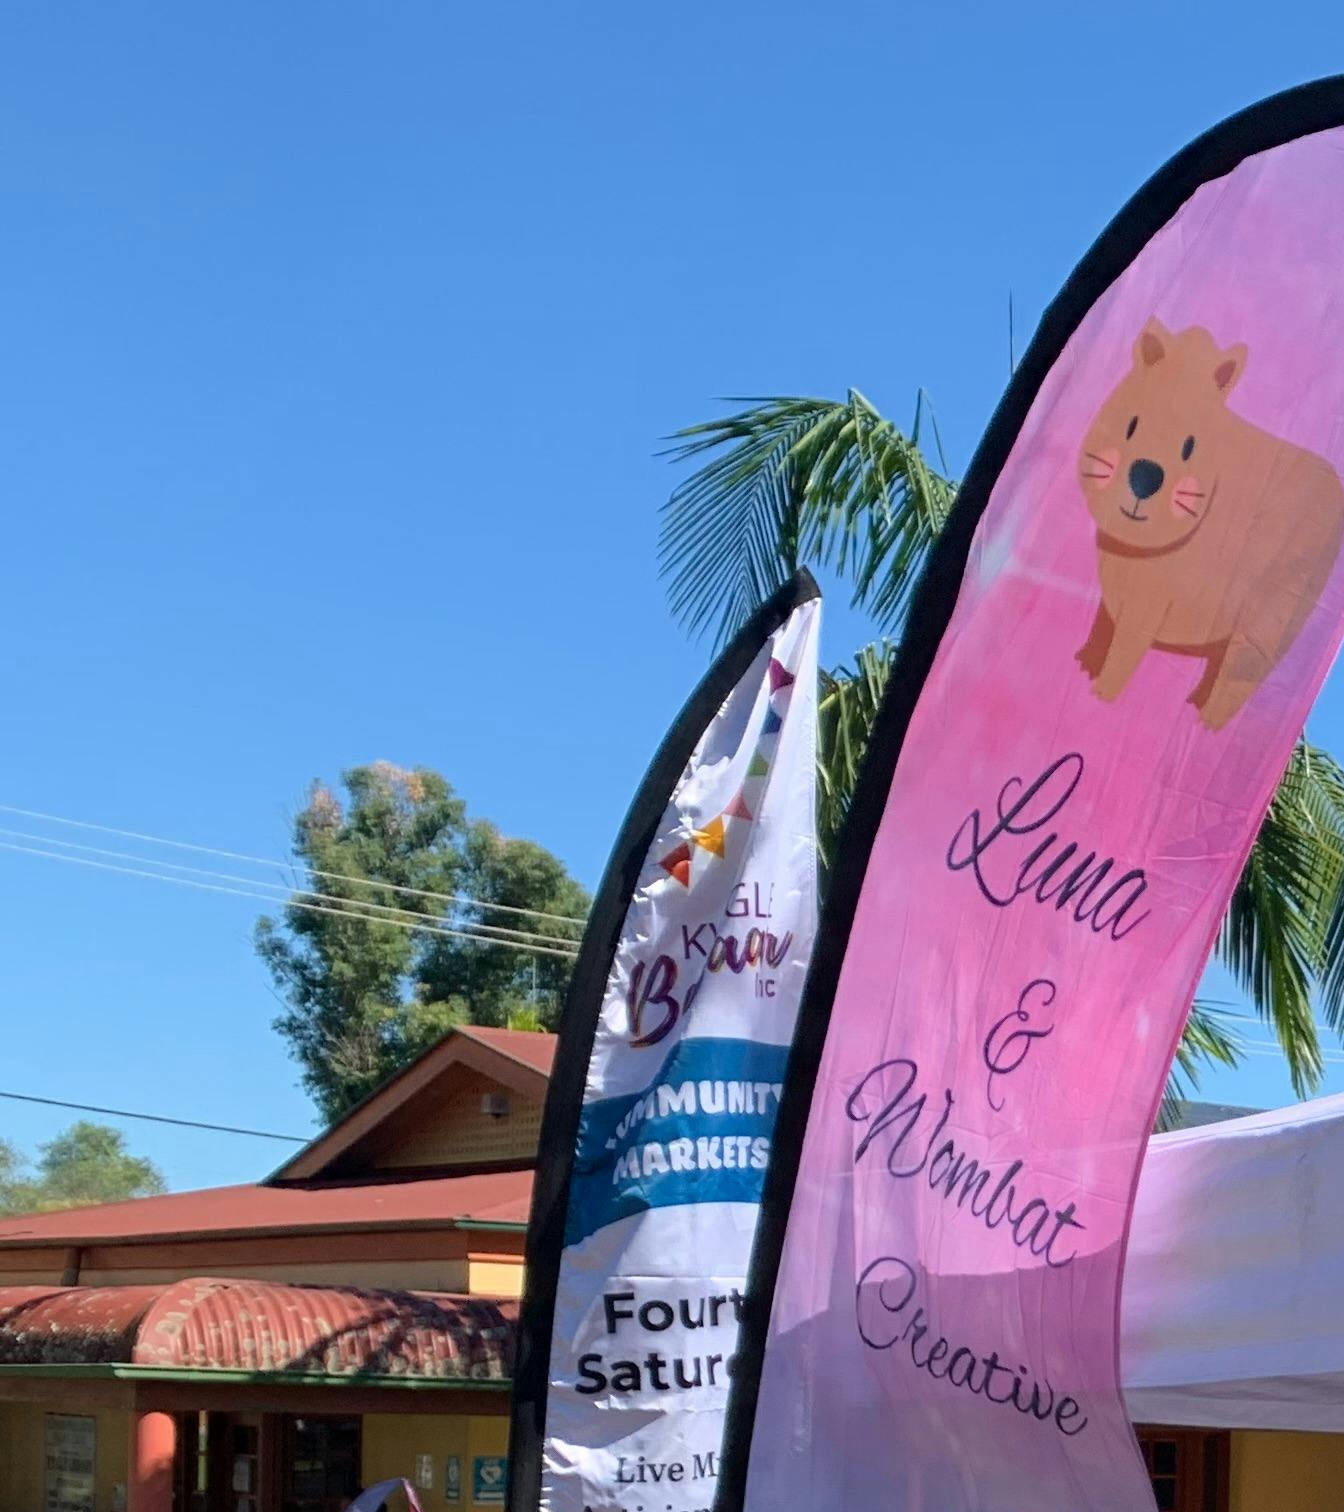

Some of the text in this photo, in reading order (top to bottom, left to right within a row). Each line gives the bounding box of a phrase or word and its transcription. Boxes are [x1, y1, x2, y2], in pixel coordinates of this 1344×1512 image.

[946, 752, 1150, 941] Luna
[984, 979, 1056, 1111] &
[613, 1136, 770, 1184] MARKETS
[845, 1058, 1087, 1268] Wombat
[603, 1288, 747, 1334] Fourt
[856, 1256, 1088, 1437] Creative
[575, 1352, 738, 1394] Satur
[614, 1456, 684, 1484] Live
